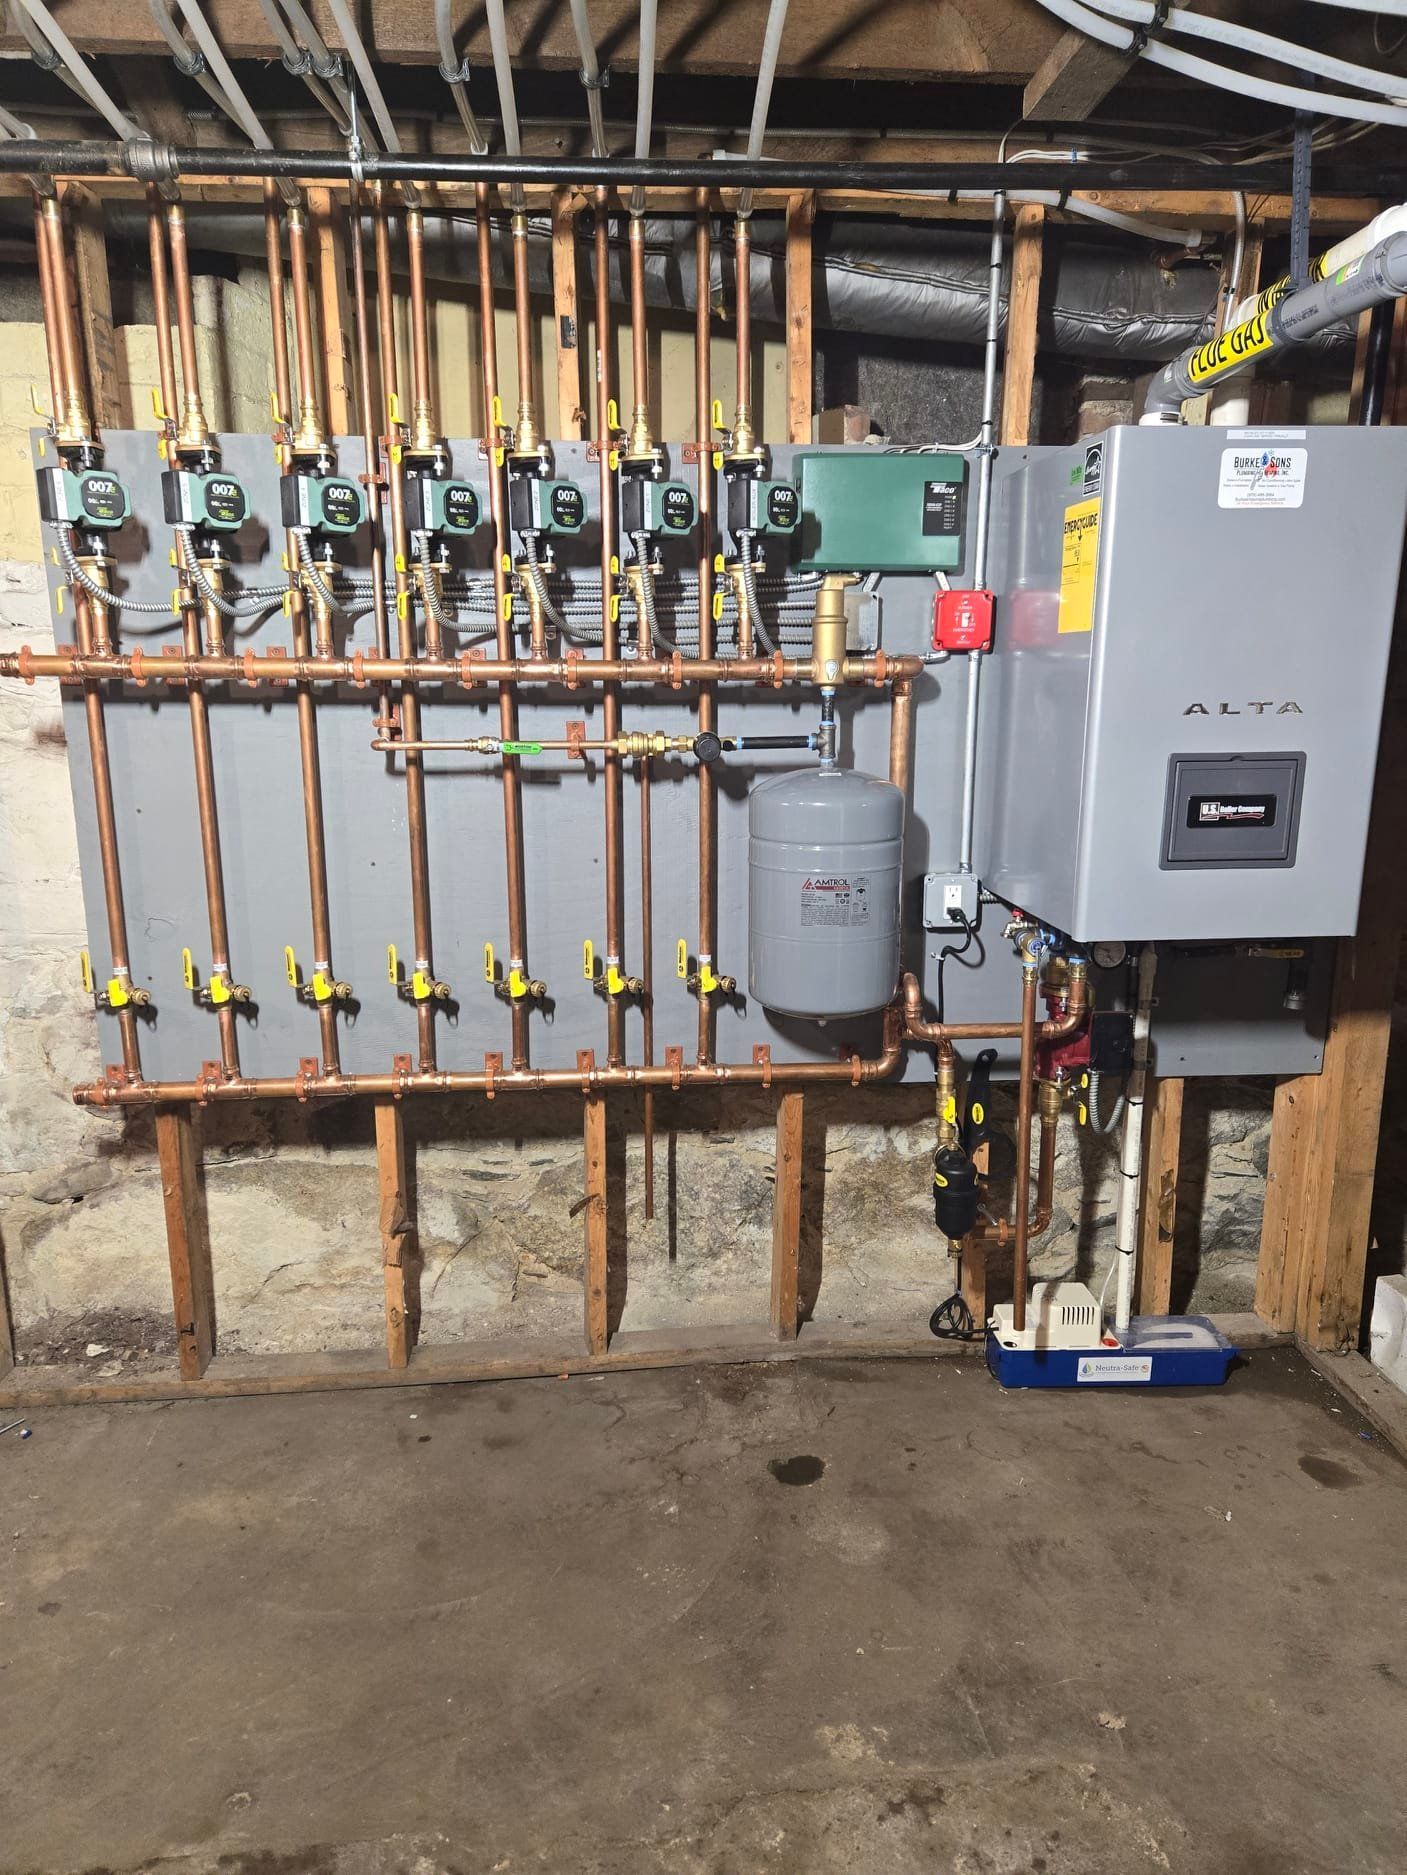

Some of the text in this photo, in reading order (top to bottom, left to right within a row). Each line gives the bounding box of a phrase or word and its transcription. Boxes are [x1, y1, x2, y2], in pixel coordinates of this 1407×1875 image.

[1190, 333, 1228, 376] FLUE
[1231, 314, 1264, 354] GAS
[1234, 456, 1260, 468] BURKE
[1270, 456, 1291, 468] SONS
[1183, 701, 1303, 716] ALTA
[1202, 804, 1218, 815] U.S.
[1095, 1364, 1139, 1372] Neutra-Safe
